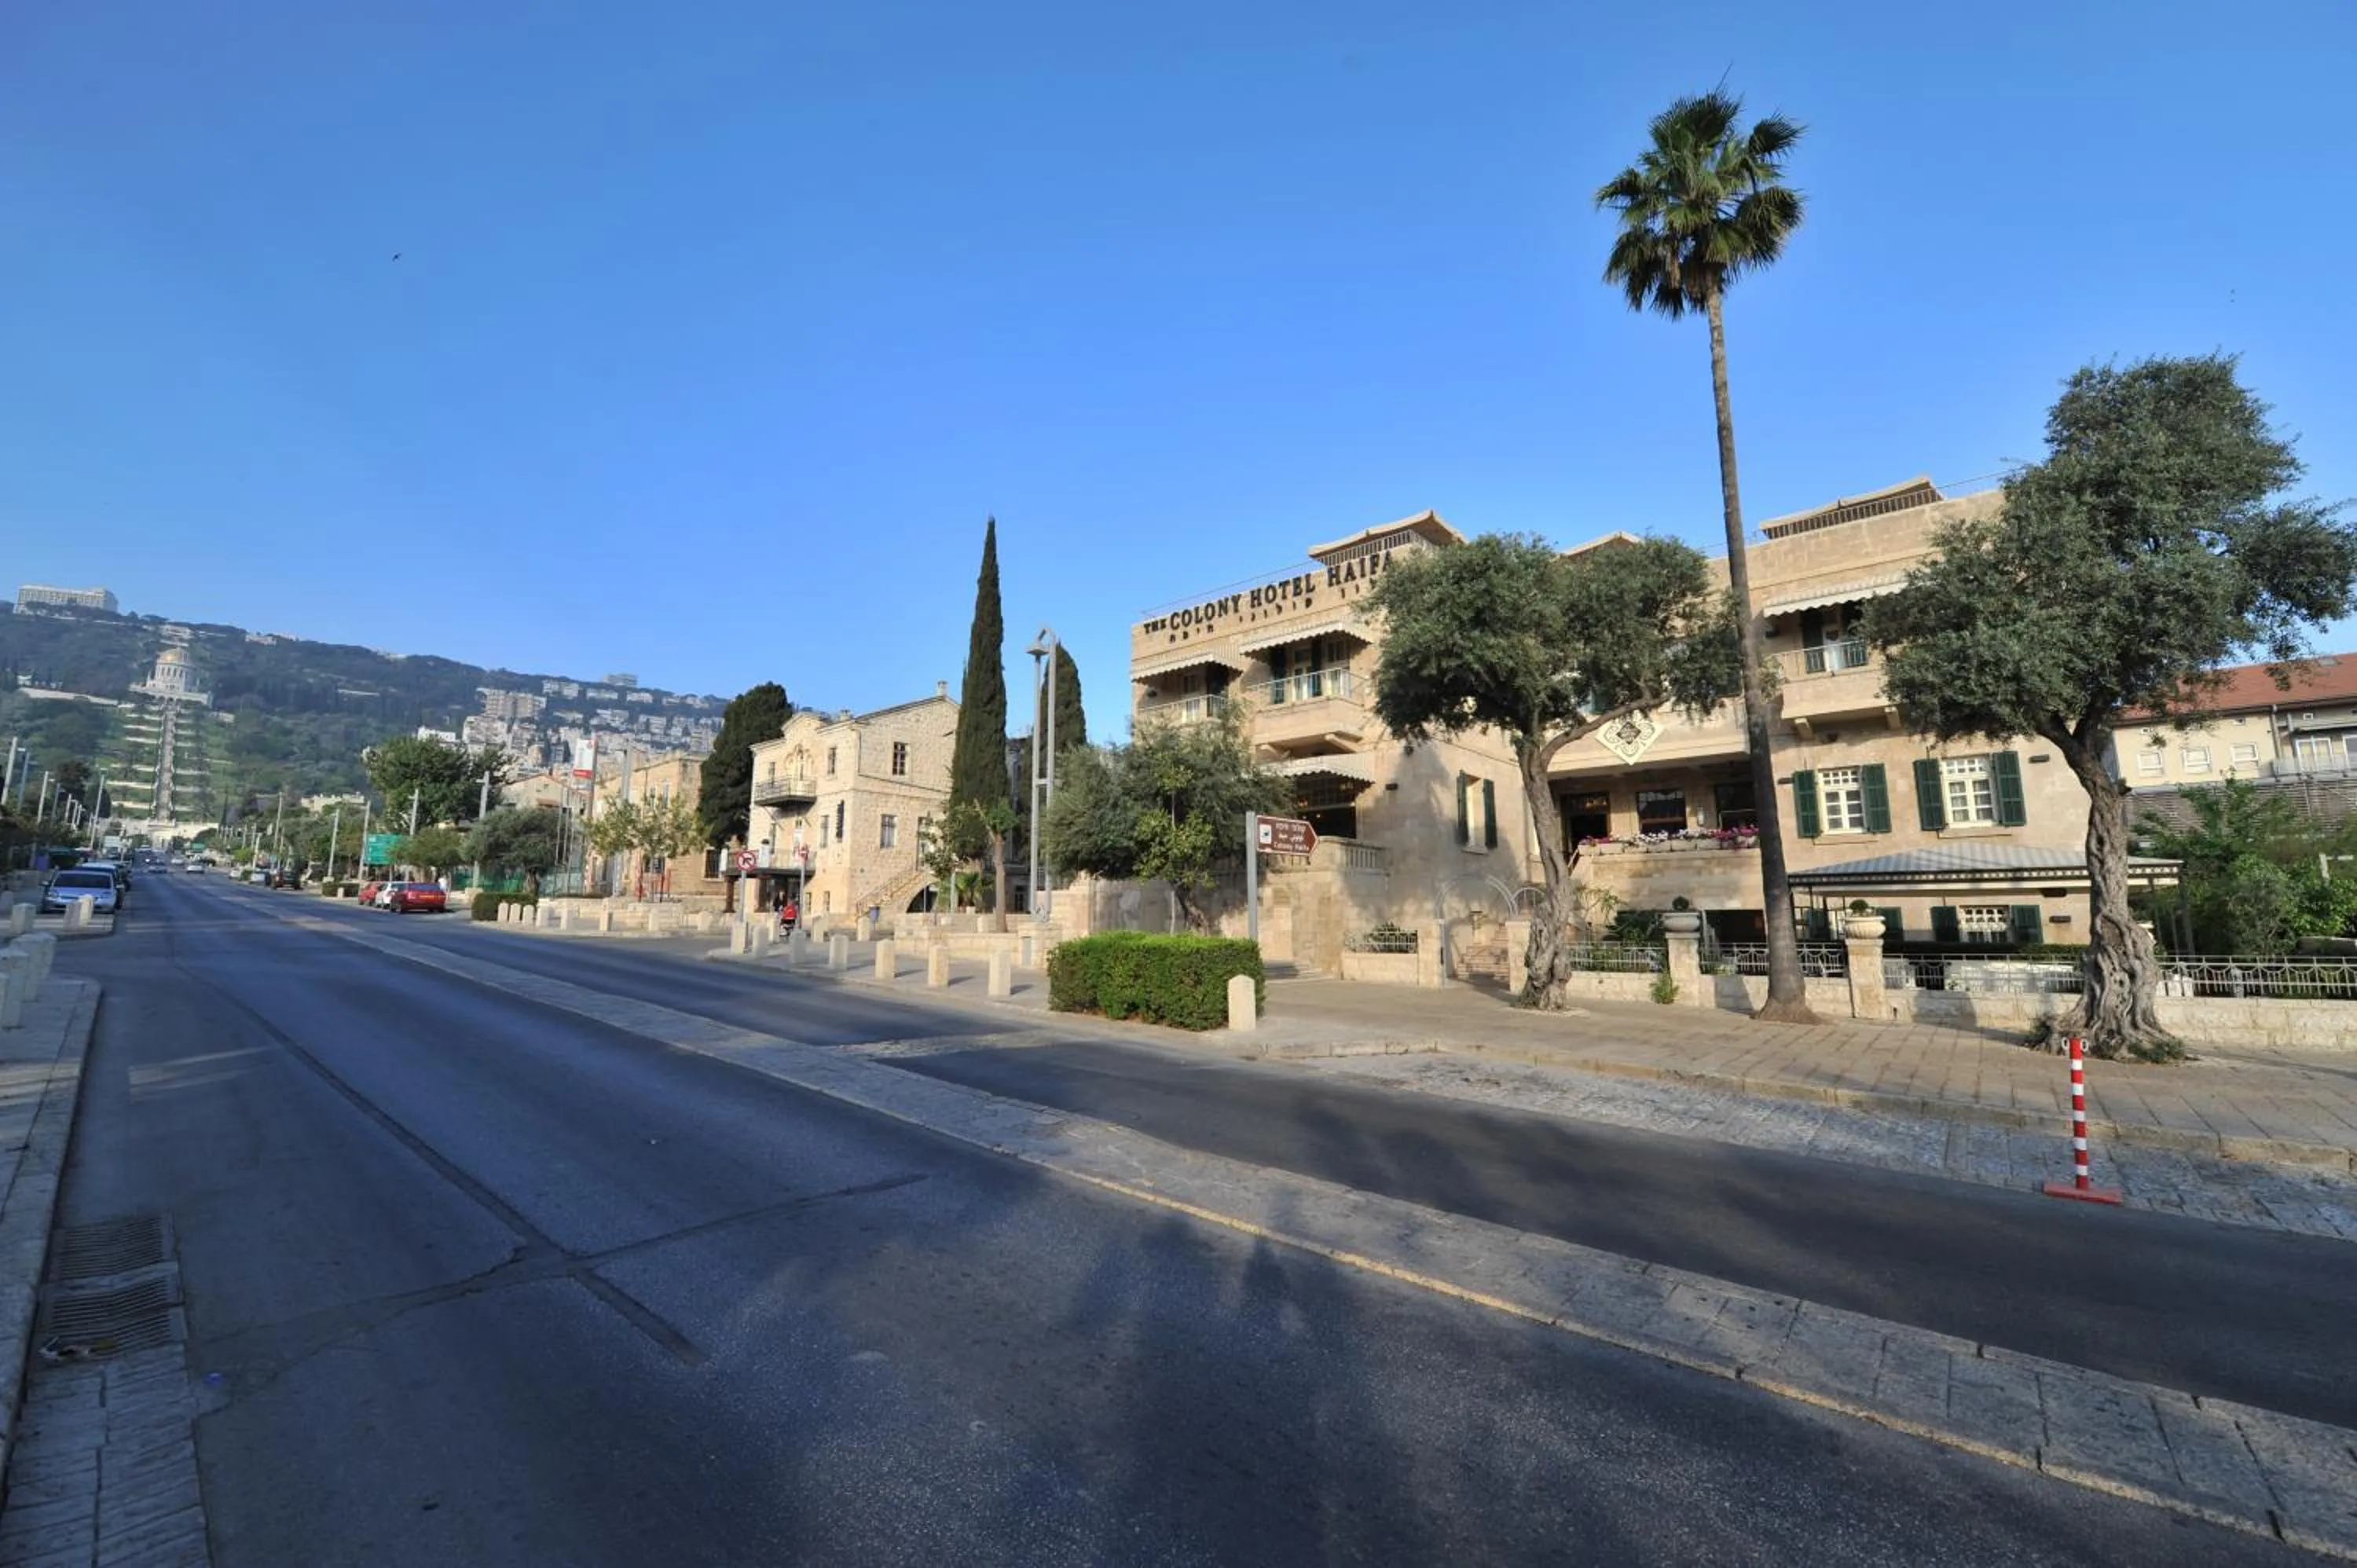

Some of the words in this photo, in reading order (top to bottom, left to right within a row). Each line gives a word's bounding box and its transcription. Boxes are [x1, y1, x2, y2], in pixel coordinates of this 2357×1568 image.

[1144, 619, 1167, 635] THE
[1170, 593, 1241, 630] COLONY
[1250, 573, 1316, 609] HOTEL
[1328, 550, 1391, 588] HAIFA
